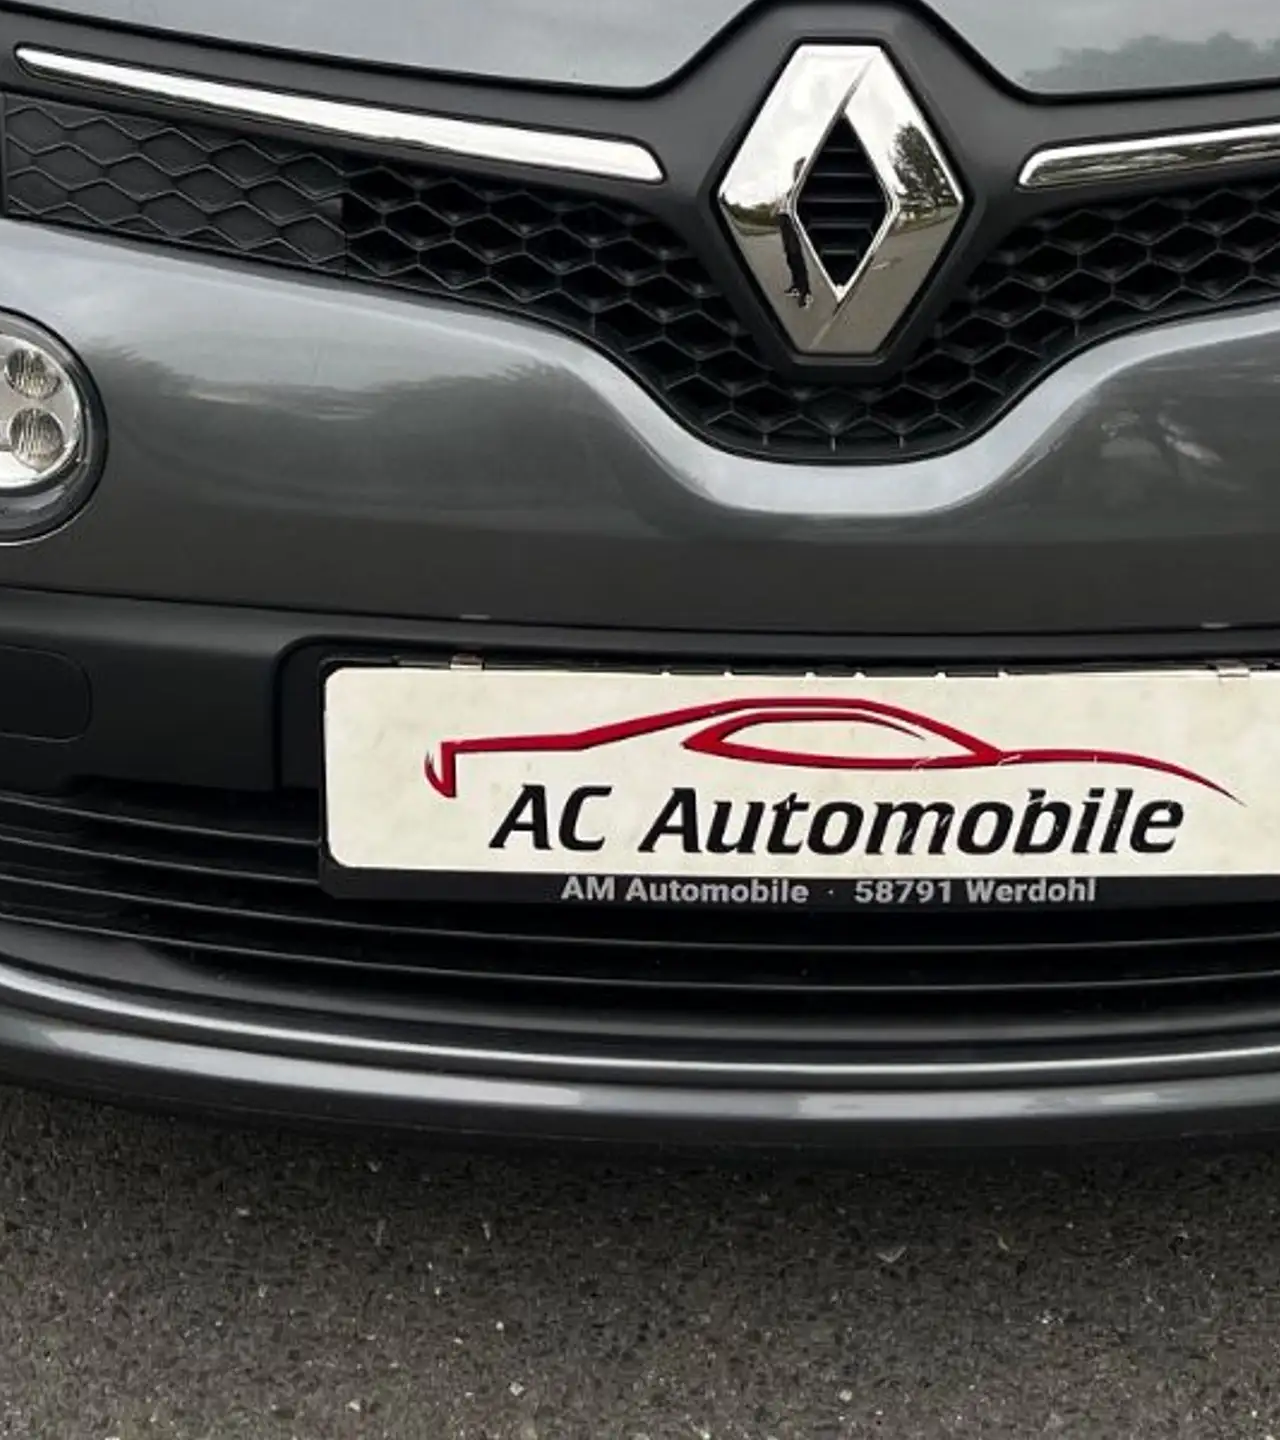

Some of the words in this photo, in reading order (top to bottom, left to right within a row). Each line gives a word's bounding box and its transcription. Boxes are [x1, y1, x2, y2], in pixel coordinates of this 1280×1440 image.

[488, 784, 614, 851] AC
[637, 787, 1185, 855] Automobile
[561, 876, 616, 901] AM
[625, 877, 810, 904] Automobile
[854, 879, 952, 904] 58791
[966, 877, 1097, 904] Werdohl
